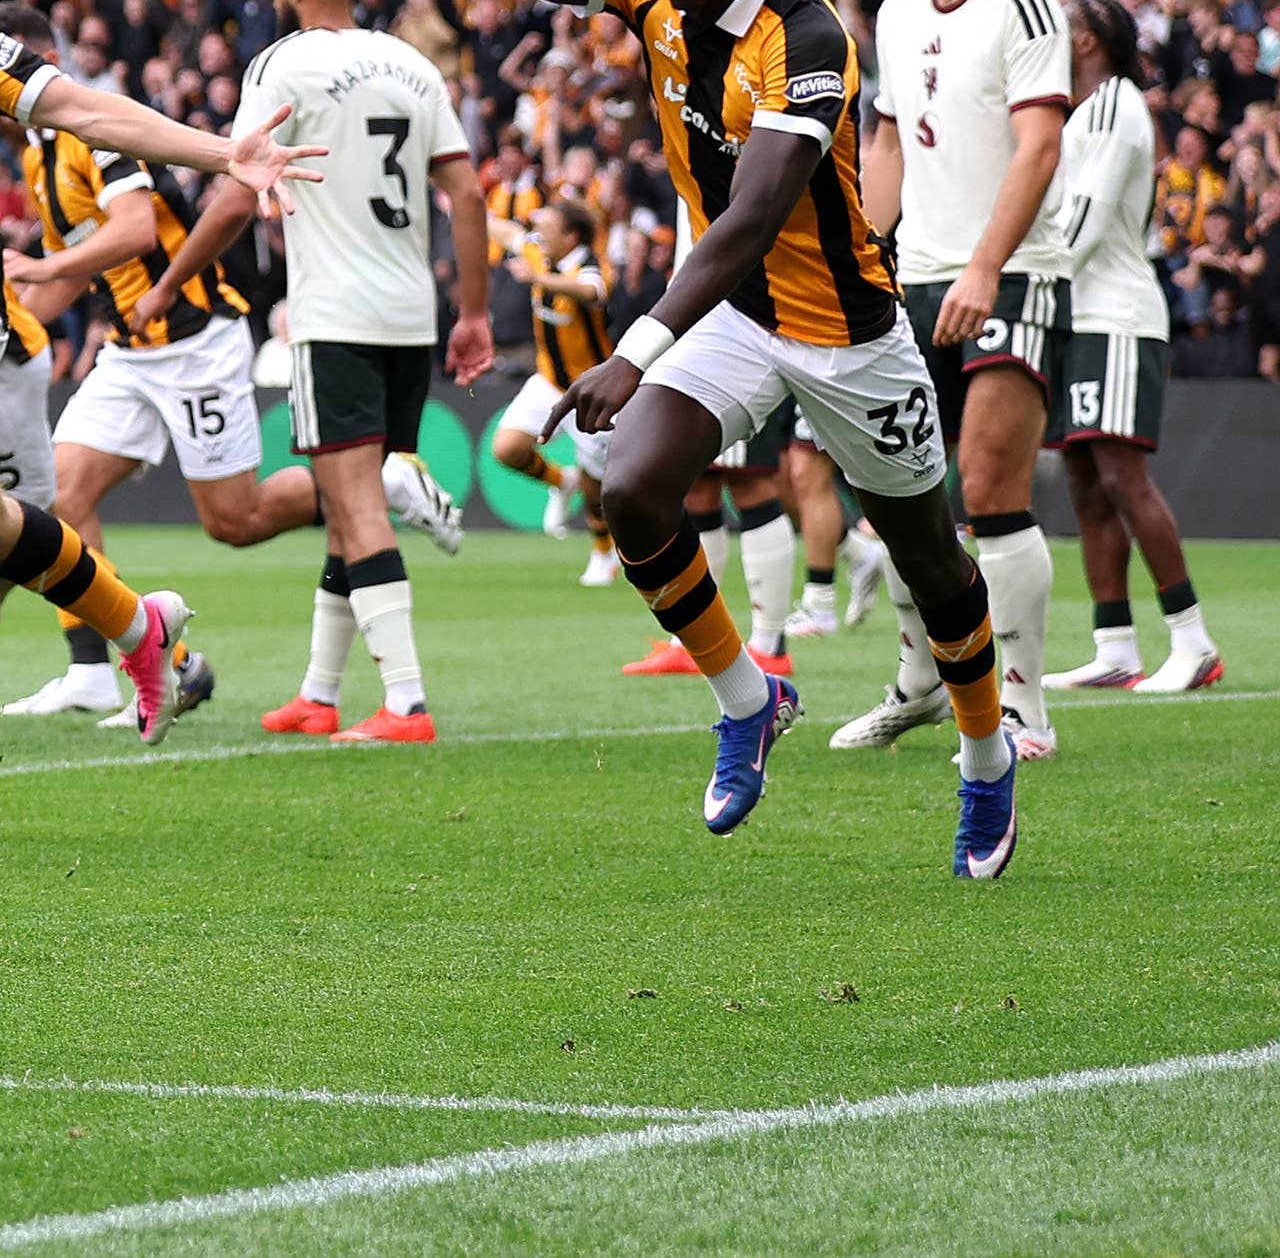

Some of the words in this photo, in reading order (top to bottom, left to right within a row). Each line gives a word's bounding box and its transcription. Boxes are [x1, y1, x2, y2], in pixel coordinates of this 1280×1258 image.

[366, 117, 410, 229] 3
[182, 395, 225, 438] 15
[867, 386, 935, 455] 32
[1070, 380, 1100, 427] 13
